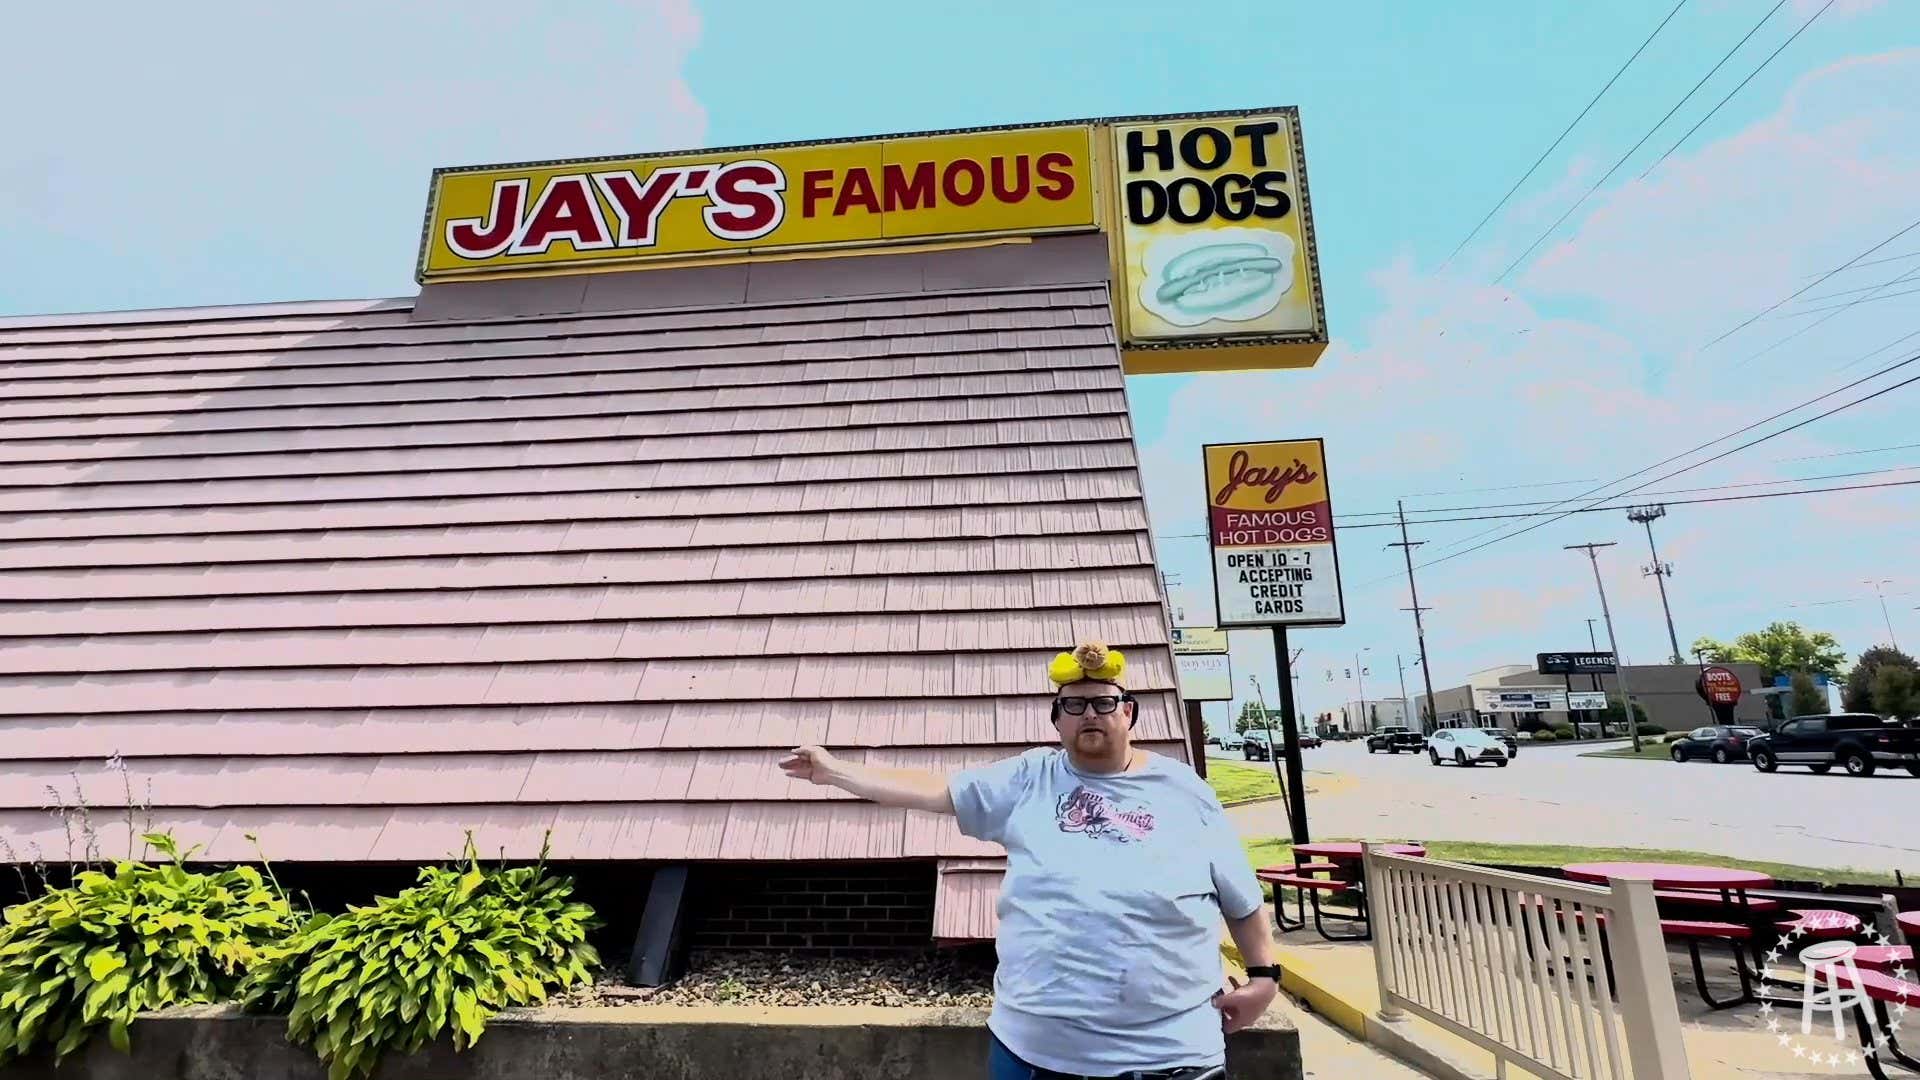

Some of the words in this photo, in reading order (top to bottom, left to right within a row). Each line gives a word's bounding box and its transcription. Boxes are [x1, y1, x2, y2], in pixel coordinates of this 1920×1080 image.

[1126, 122, 1279, 172] HOT
[445, 160, 787, 260] JAY'S
[802, 152, 1076, 219] FAMOUS
[1126, 170, 1291, 226] DOGS
[1215, 450, 1318, 506] Jay's
[1226, 510, 1317, 528] FAMOUS
[1220, 530, 1261, 545] HOT
[1264, 527, 1328, 543] DOGS
[1227, 553, 1264, 568] OPEN
[1272, 553, 1287, 567] 10
[1304, 551, 1311, 565] 7
[1239, 567, 1313, 583] ACCEPTING
[1250, 584, 1304, 598] CREDIT
[1255, 599, 1304, 614] CARDS
[1574, 656, 1616, 666] LEGENDS
[1706, 672, 1732, 682] BOOTS
[1715, 692, 1732, 702] FREE
